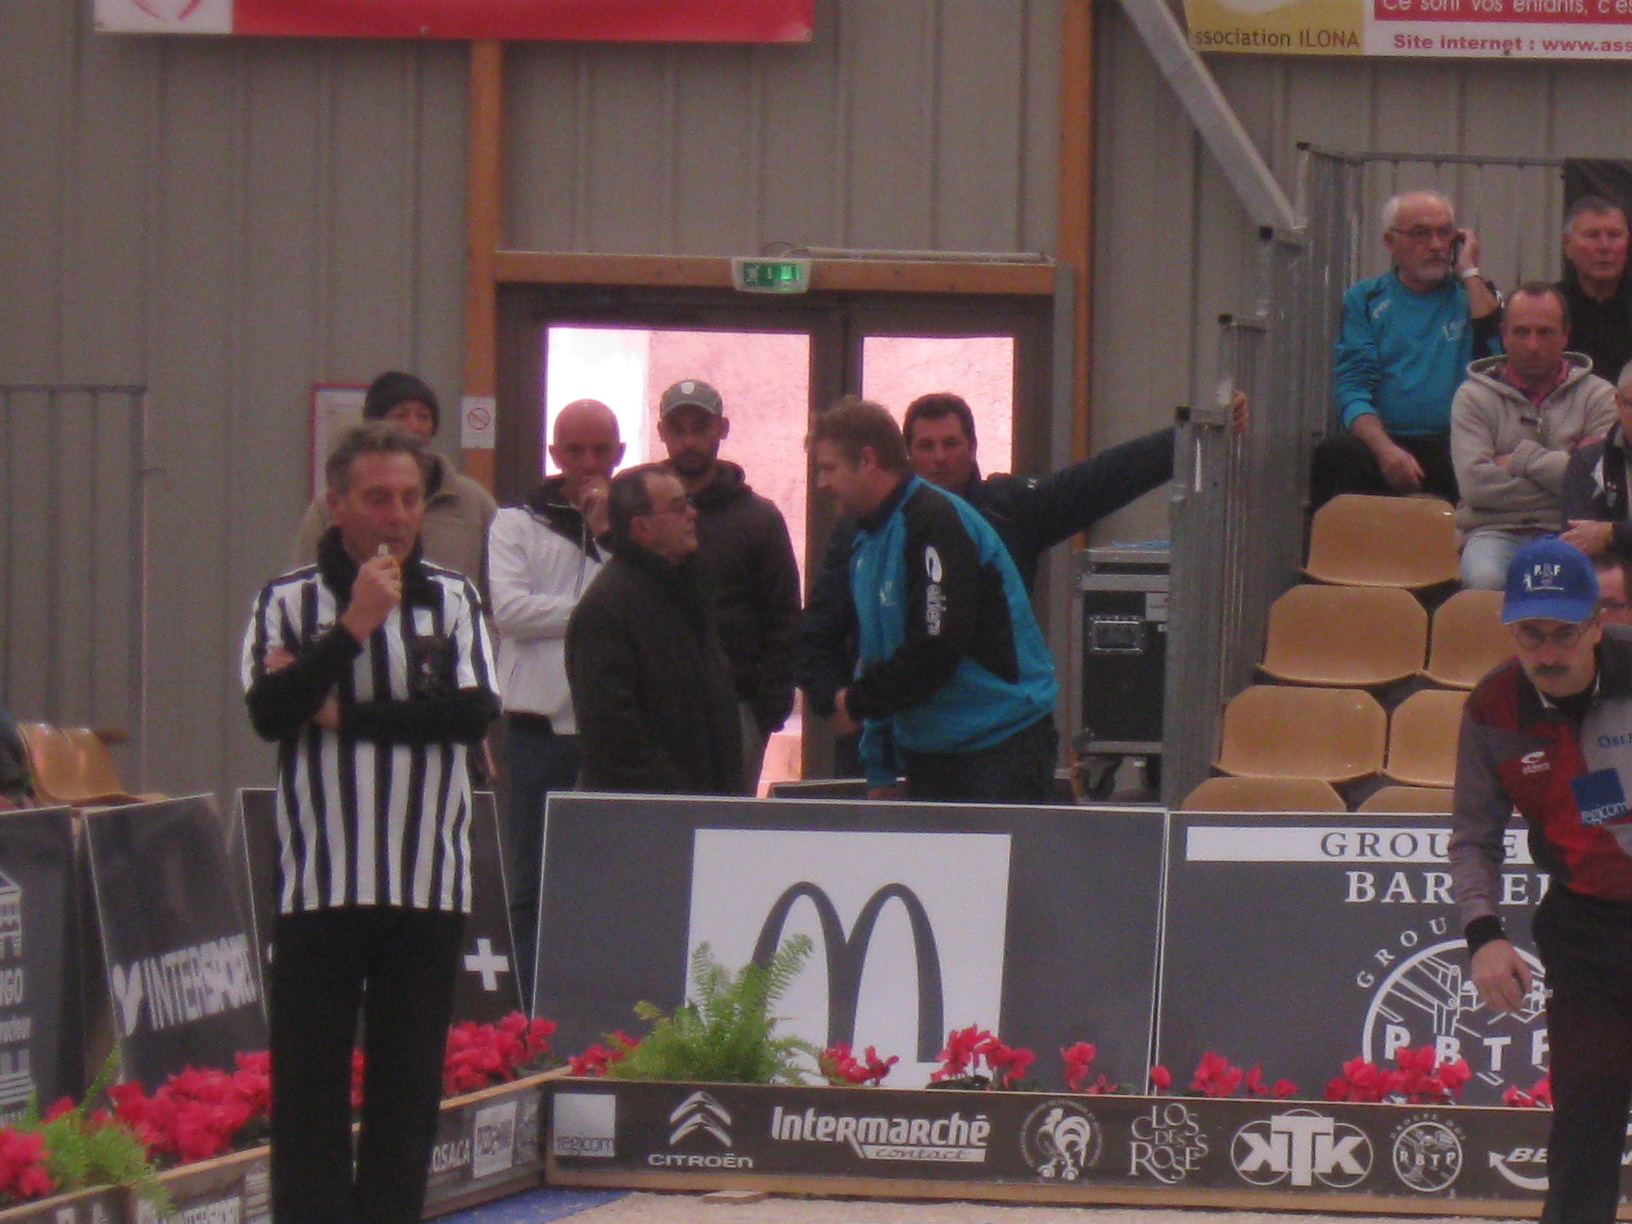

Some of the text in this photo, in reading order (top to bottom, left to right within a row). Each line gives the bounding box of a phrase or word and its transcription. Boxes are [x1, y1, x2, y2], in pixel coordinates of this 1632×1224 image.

[1188, 28, 1359, 47] ssociation ILONA
[1393, 33, 1433, 49] Site
[1440, 35, 1522, 51] internet
[1320, 831, 1518, 858] GROUE
[771, 1105, 992, 1159] Intermarché
